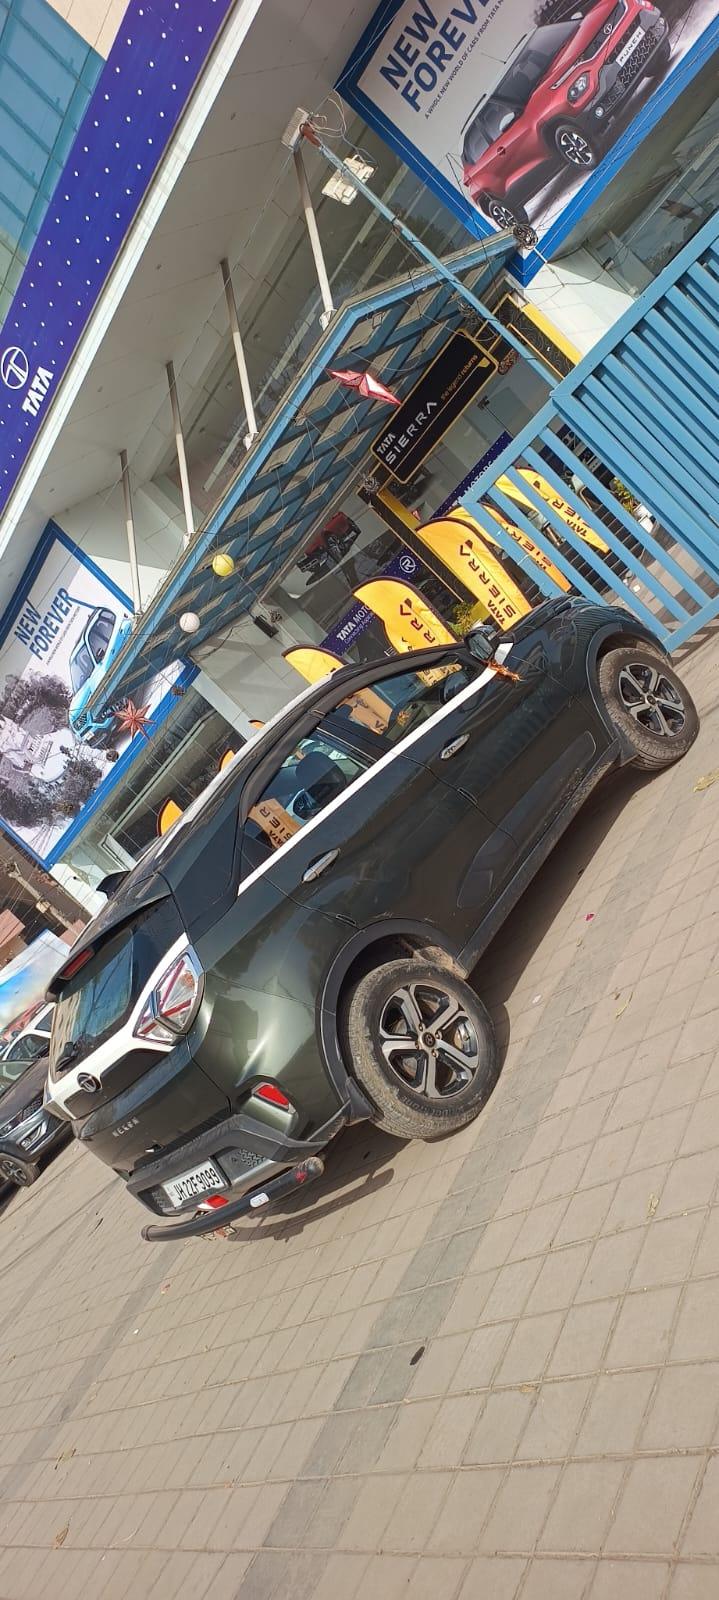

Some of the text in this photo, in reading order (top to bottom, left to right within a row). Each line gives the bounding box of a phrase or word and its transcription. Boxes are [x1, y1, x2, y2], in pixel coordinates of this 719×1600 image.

[379, 0, 438, 90] NEW
[401, 0, 489, 112] FOREV
[426, 93, 442, 114] WHOLE
[438, 79, 451, 95] NEW
[447, 59, 464, 81] WORLD
[466, 36, 479, 52] CARS
[476, 17, 491, 37] FROM
[487, 4, 500, 19] TATA
[619, 31, 643, 62] PUNCH
[22, 366, 54, 417] TATA
[376, 433, 396, 454] TATA
[385, 402, 437, 465] SIERRA
[566, 518, 588, 538] TATA
[459, 544, 517, 618] SIERRA
[14, 603, 41, 645] NEW
[30, 588, 73, 660] FOREVER
[337, 621, 356, 641] TATA
[400, 604, 435, 643] RRA
[487, 602, 505, 625] TATA
[173, 1167, 220, 1200] JH22F9099
